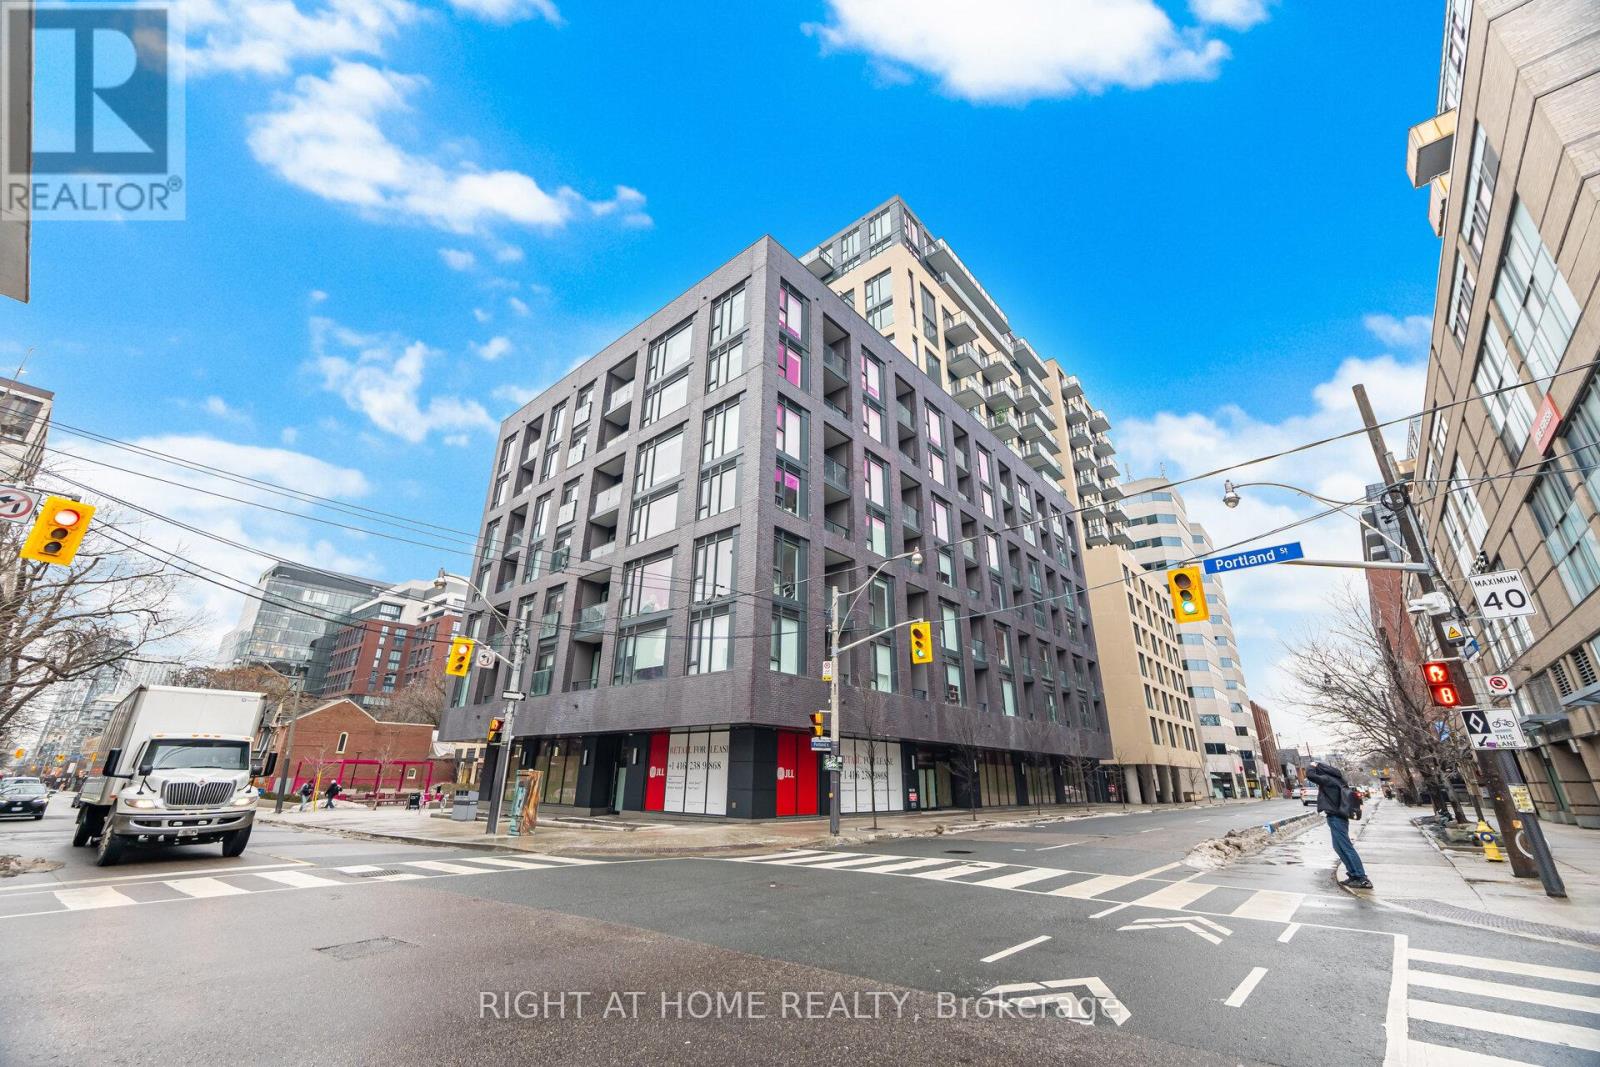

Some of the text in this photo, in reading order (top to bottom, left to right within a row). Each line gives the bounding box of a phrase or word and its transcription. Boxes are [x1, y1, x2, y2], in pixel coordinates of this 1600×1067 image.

[1215, 547, 1289, 571] Portland St
[1474, 575, 1519, 588] MAXIMUM
[1483, 588, 1526, 610] 40
[693, 745, 706, 754] FOR
[709, 744, 729, 754] LEAS
